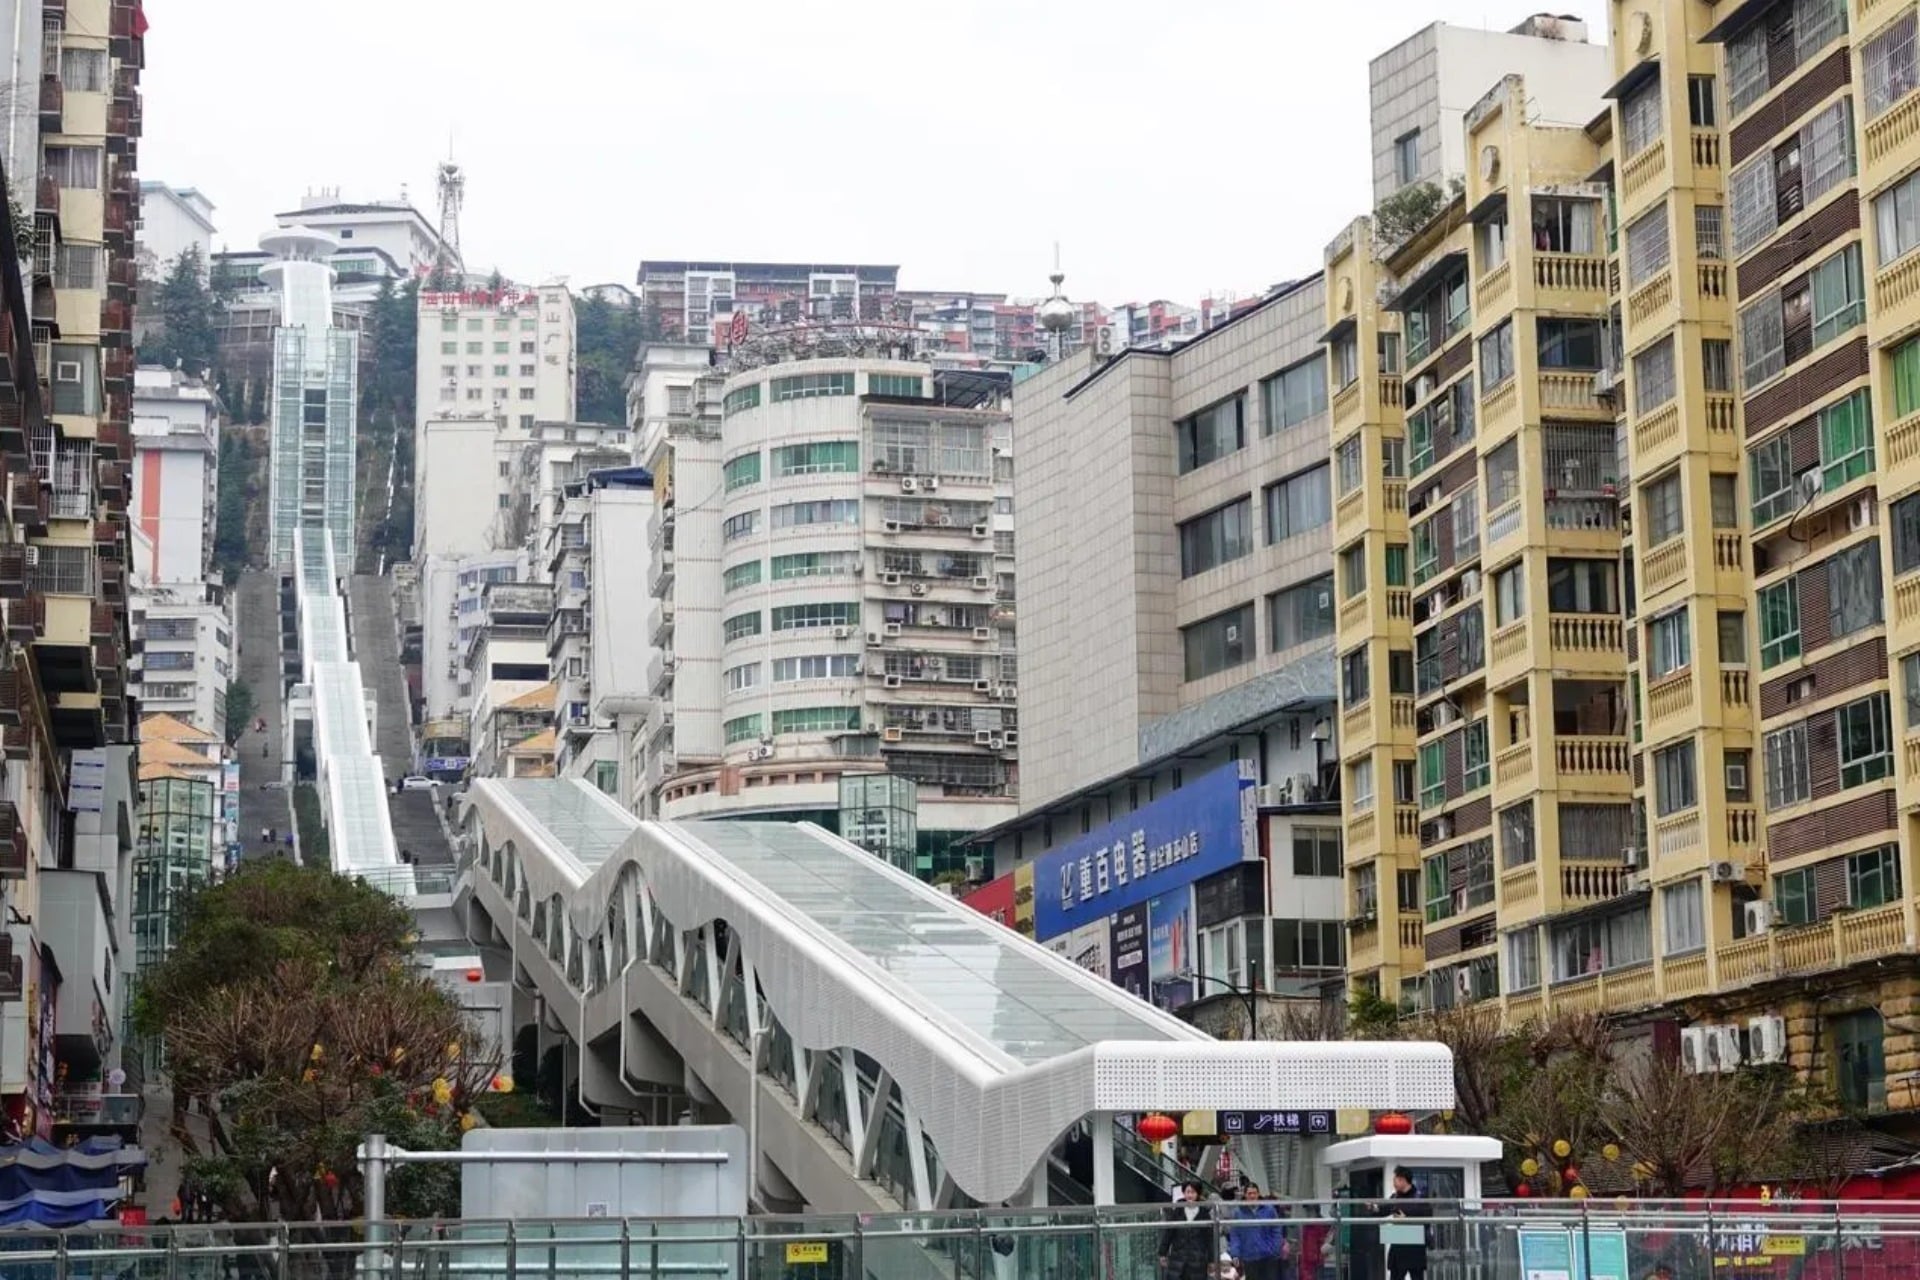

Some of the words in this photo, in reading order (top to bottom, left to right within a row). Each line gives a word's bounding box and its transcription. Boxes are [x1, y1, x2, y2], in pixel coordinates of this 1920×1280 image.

[1079, 829, 1147, 902] 重百电器
[1272, 1112, 1300, 1127] 扶梯
